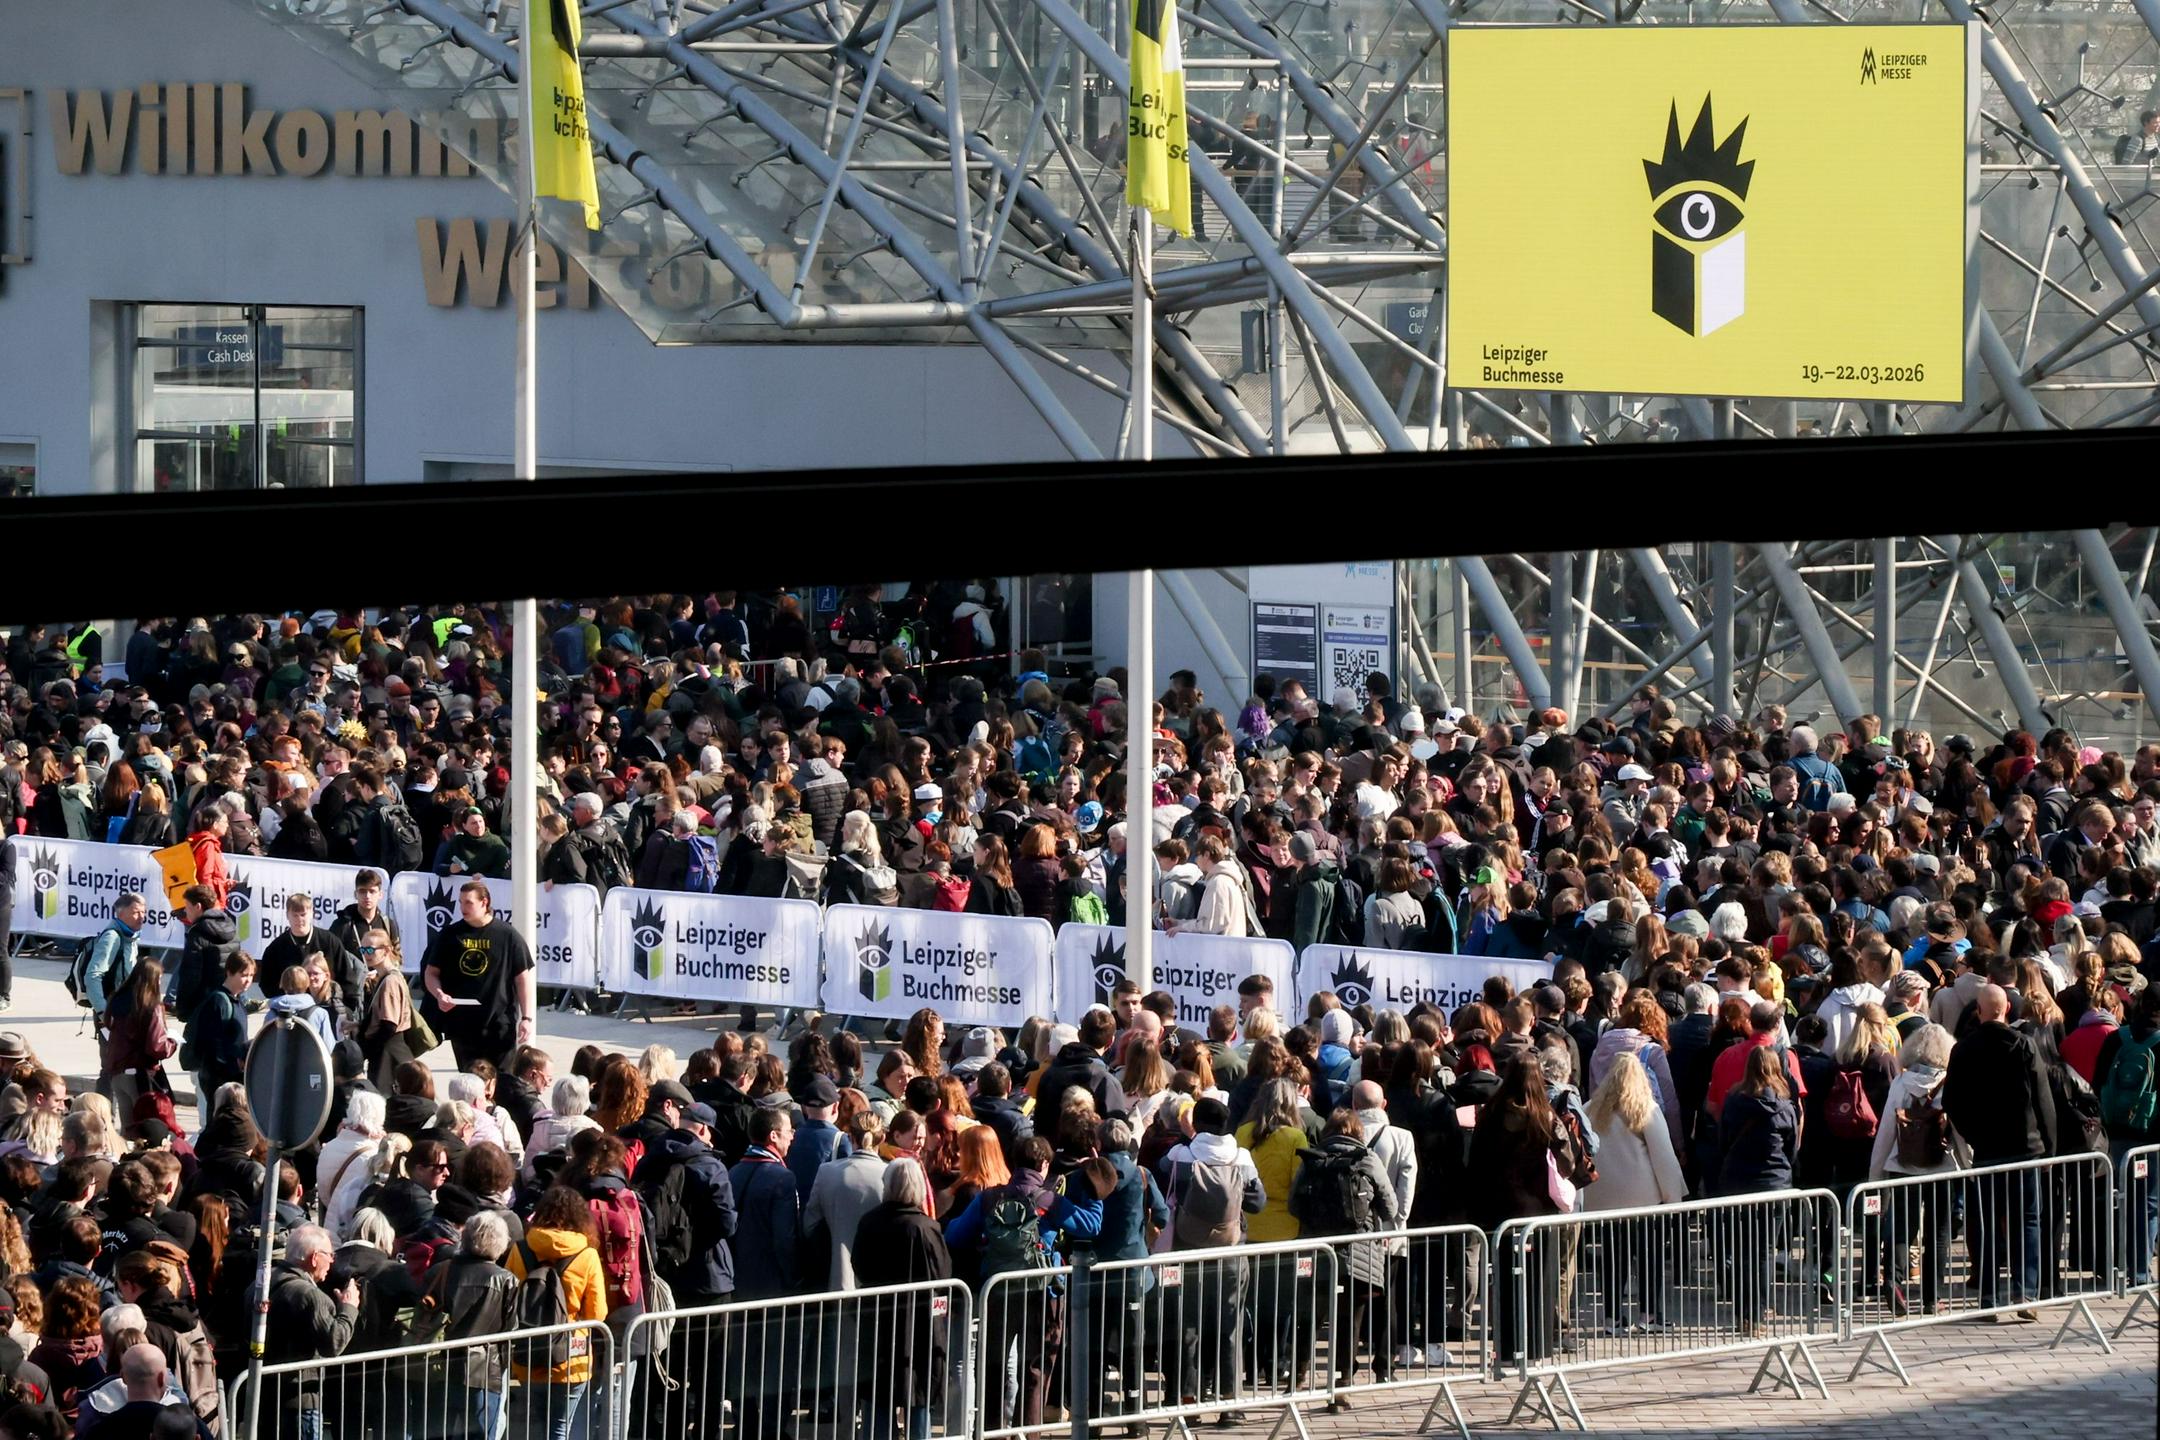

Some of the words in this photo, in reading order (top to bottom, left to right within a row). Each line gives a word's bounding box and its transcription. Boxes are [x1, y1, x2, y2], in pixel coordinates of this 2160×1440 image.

[1881, 54, 1927, 66] LEIPZIGER
[1881, 68, 1912, 79] MESSE
[215, 332, 249, 344] Kassen
[207, 350, 231, 363] Cash
[233, 349, 255, 362] Desk
[1483, 344, 1548, 366] Leipziger
[1483, 365, 1564, 384] Buchmesse
[67, 864, 148, 896] Leipziger
[676, 920, 767, 955] Leipziger
[676, 953, 791, 984] Buchmesse
[902, 940, 998, 975] Leipziger
[902, 974, 1021, 1005] Buchmesse
[1153, 960, 1236, 997] eipziger
